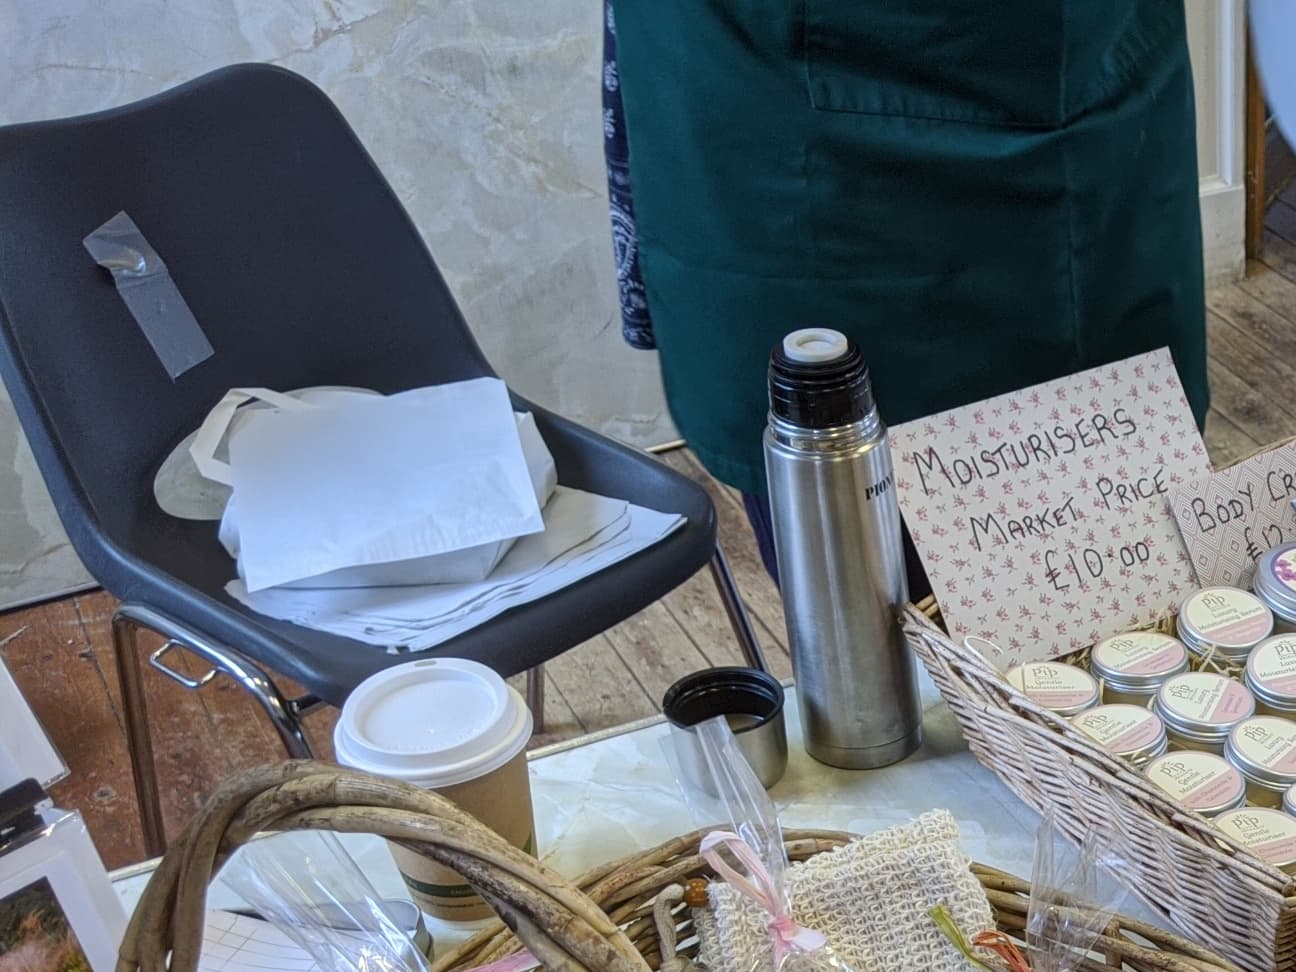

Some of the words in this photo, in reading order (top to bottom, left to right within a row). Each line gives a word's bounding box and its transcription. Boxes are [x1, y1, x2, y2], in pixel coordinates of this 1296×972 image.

[913, 408, 1137, 496] MOISTURISERS
[970, 497, 1078, 552] MARKET
[1096, 467, 1169, 511] PRICE
[1191, 484, 1254, 533] BODY
